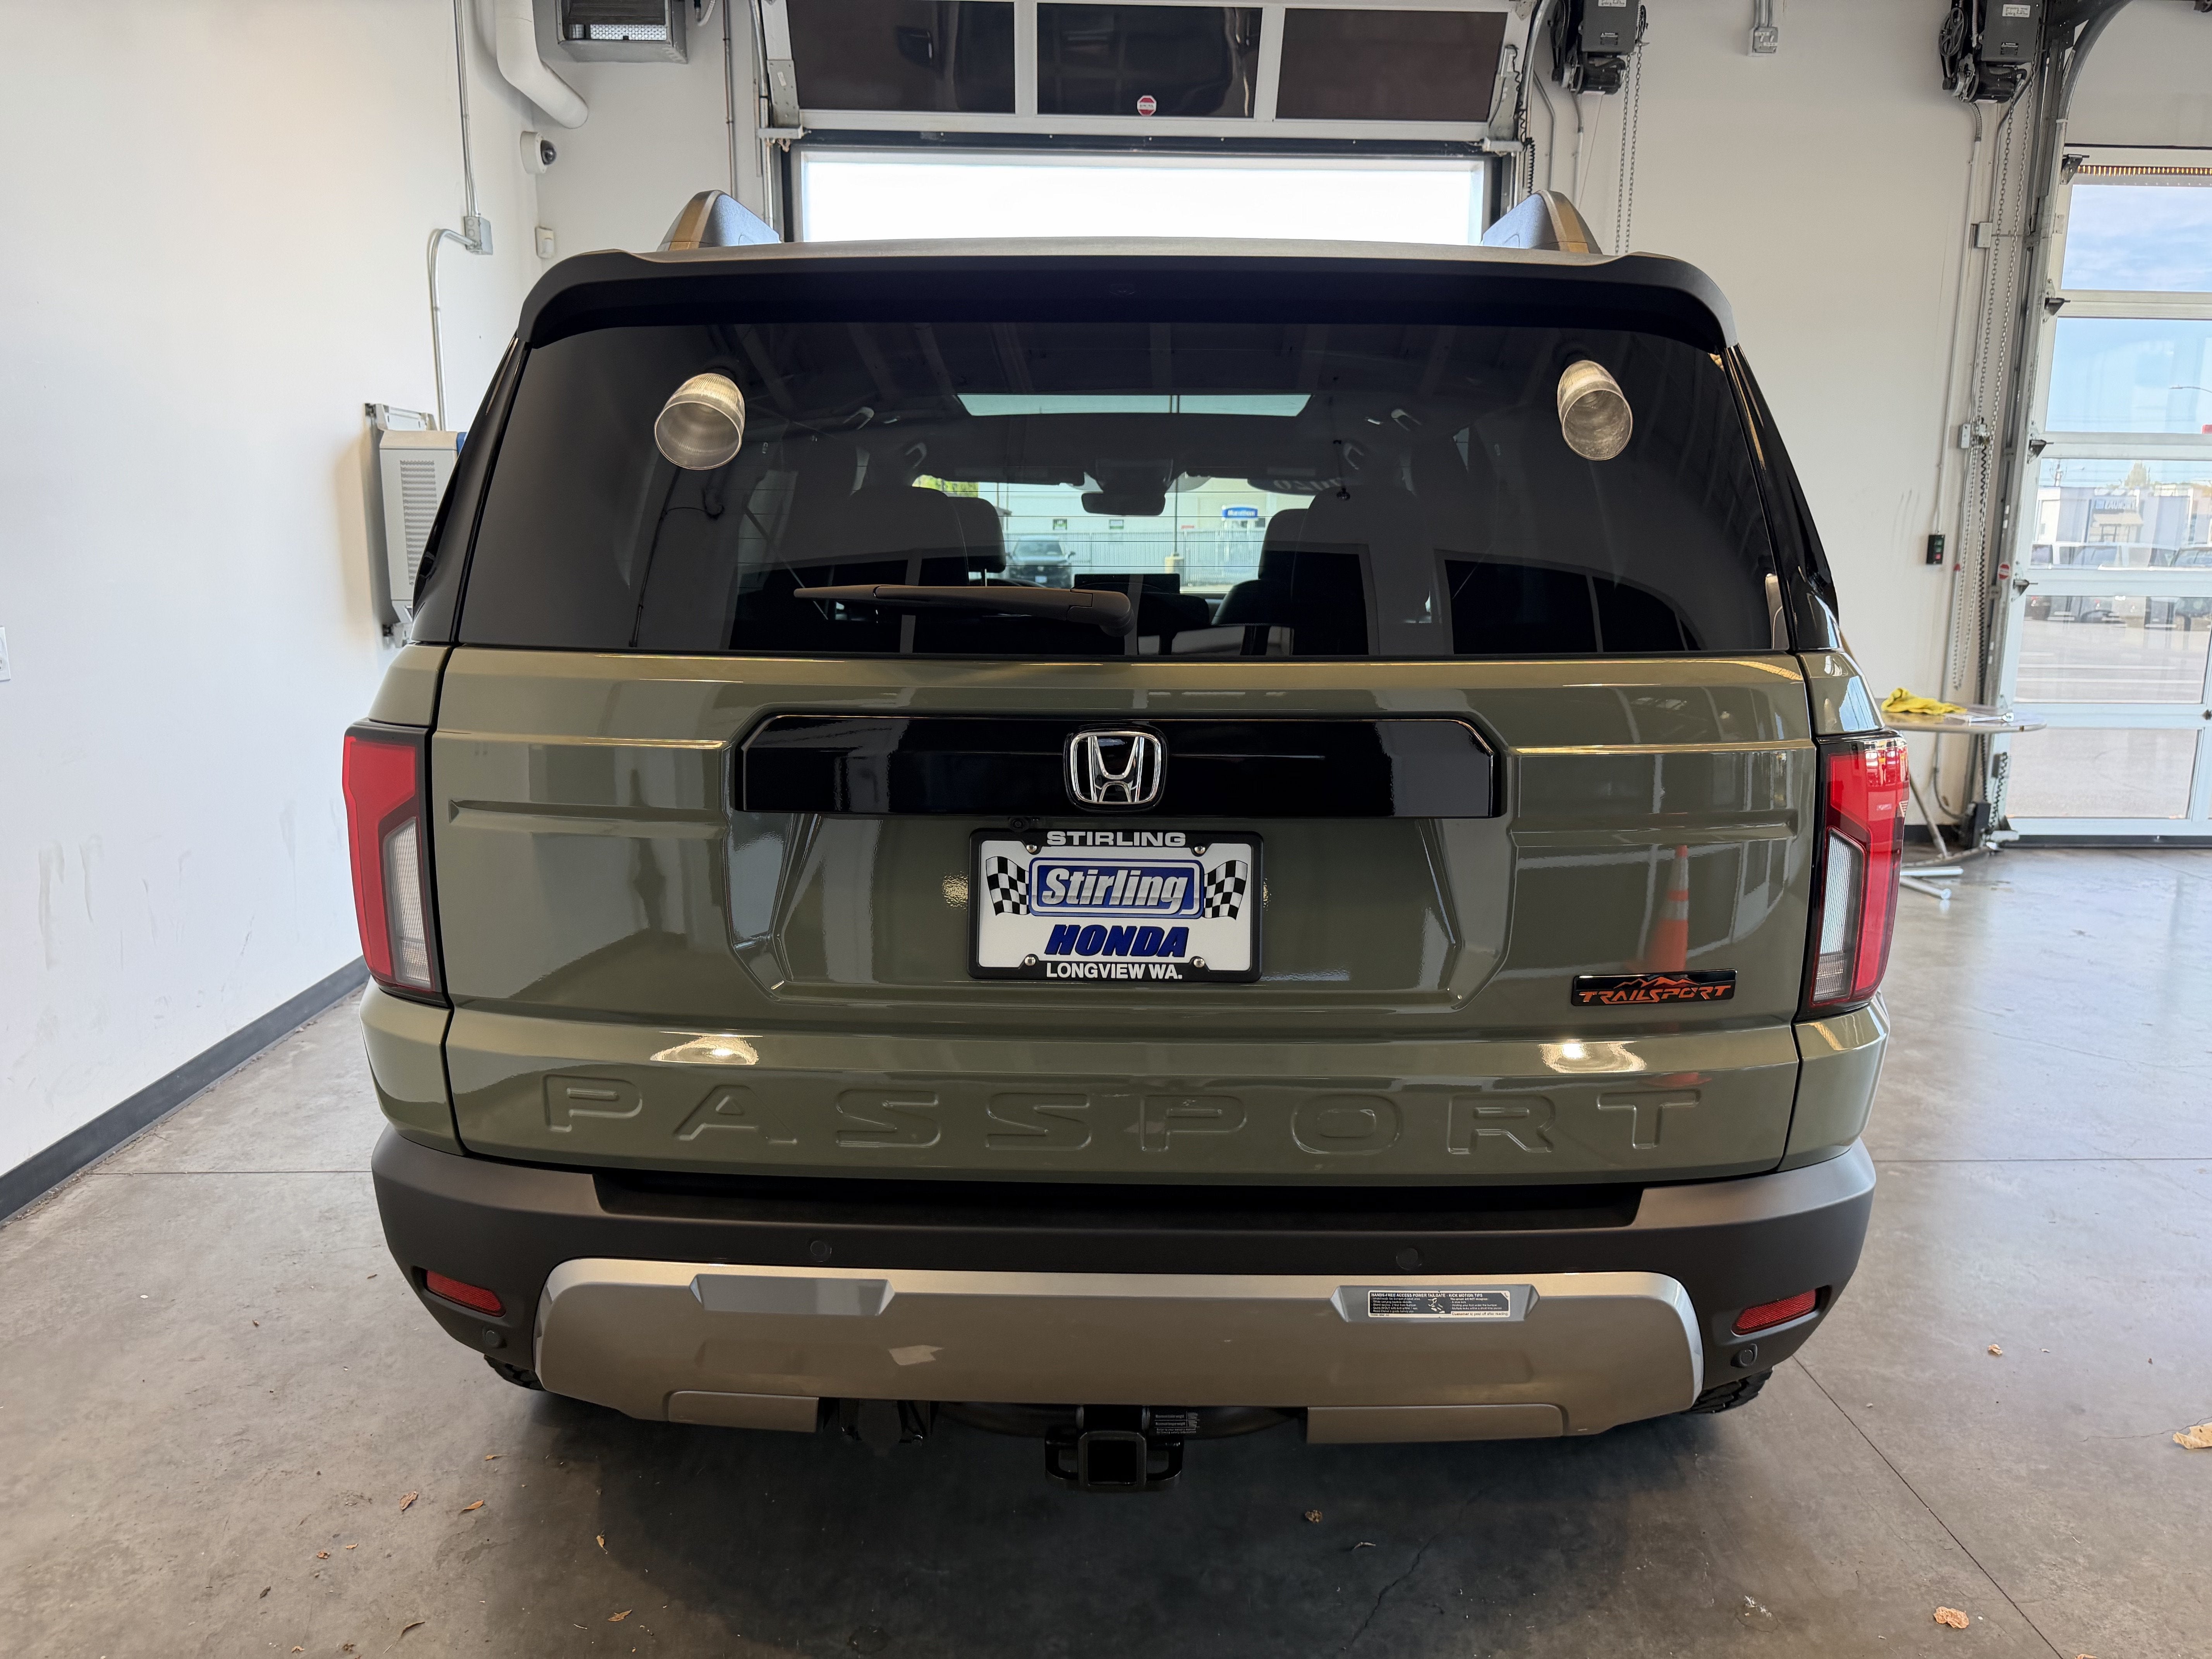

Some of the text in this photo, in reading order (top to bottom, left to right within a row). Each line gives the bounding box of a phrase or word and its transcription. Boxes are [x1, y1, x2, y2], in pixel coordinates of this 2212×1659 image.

[1047, 831, 1186, 847] STIRLING
[1041, 867, 1188, 914] Stirling
[1044, 924, 1190, 958] HONDA
[1046, 963, 1183, 979] LONGVIEW WA.
[1579, 985, 1731, 1005] TRAILSPORT
[542, 1073, 1701, 1153] PASSPORT
